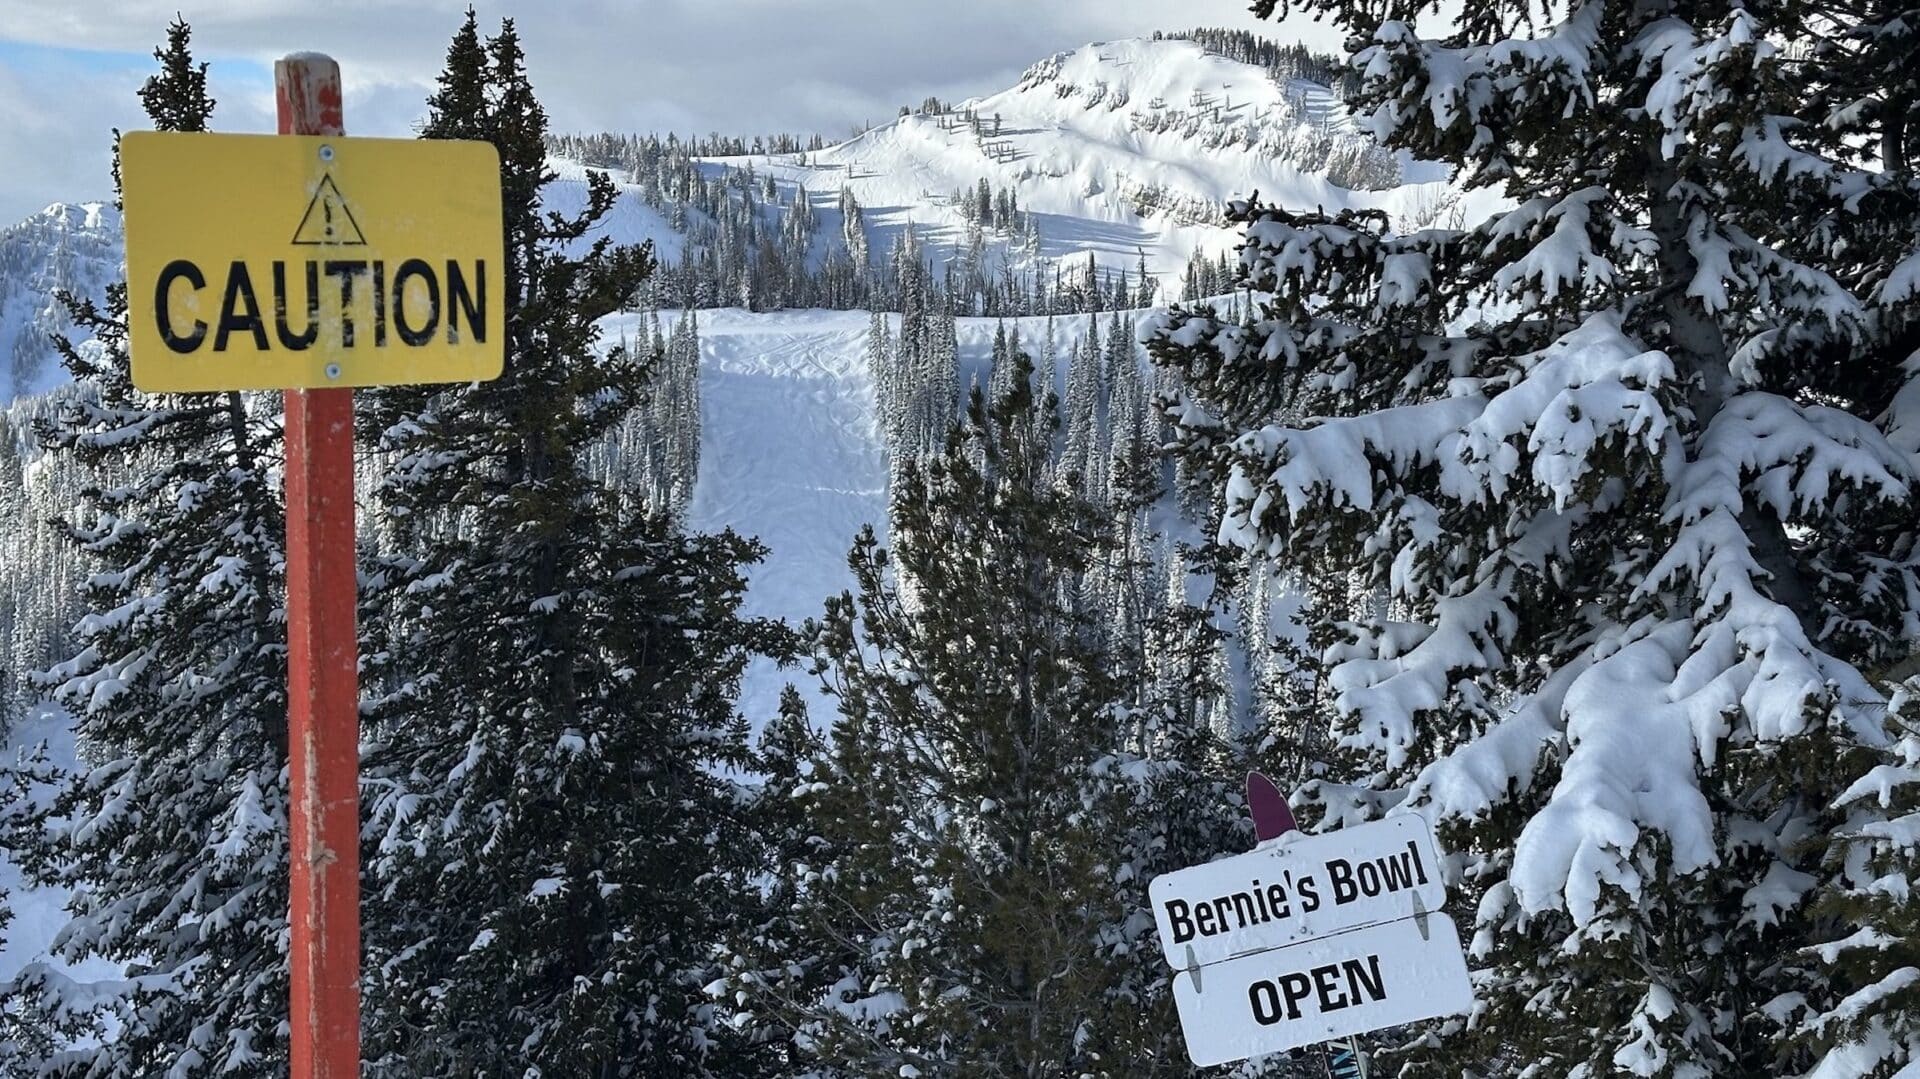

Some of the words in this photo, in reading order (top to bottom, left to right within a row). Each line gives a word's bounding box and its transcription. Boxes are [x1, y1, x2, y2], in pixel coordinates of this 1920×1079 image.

[155, 259, 487, 354] CAUTION
[1165, 870, 1319, 944] Bernie's
[1325, 840, 1428, 905] Bowl
[1248, 955, 1387, 1026] OPEN
